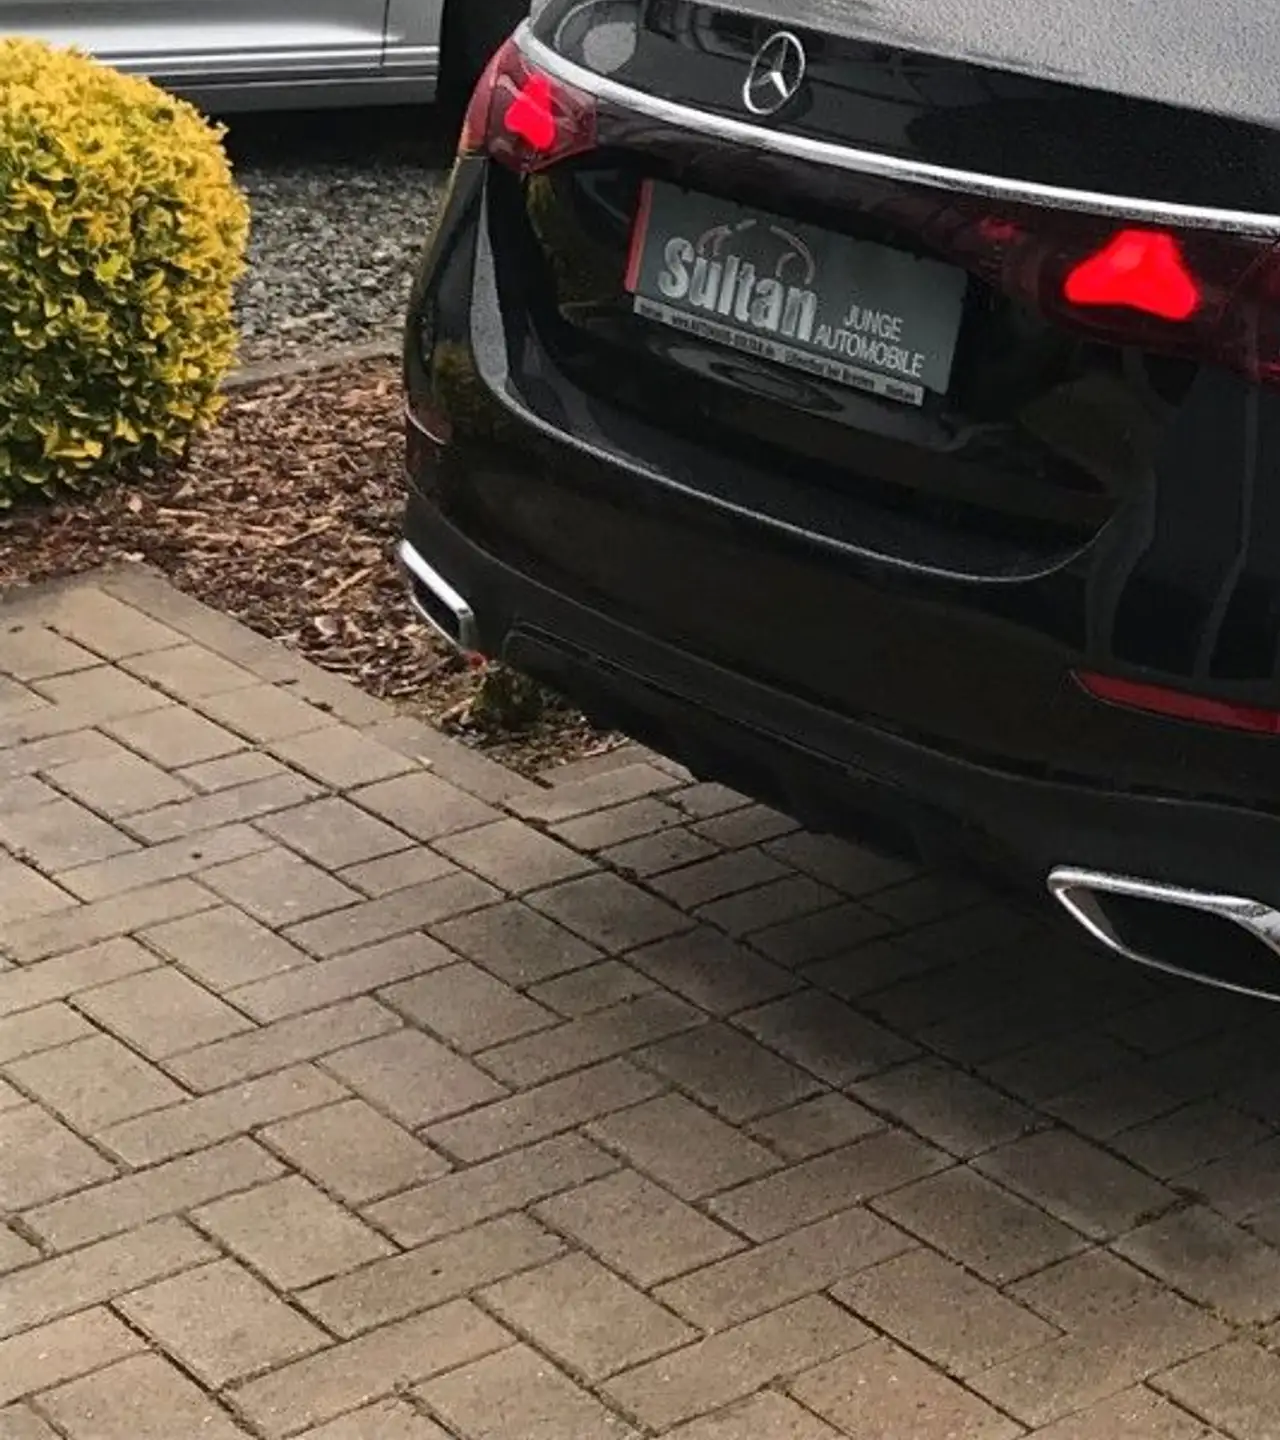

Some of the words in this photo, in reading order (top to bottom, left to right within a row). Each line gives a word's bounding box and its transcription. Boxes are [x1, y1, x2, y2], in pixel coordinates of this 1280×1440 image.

[658, 236, 818, 343] Sultan
[814, 323, 925, 379] AUTOMOBILE
[845, 305, 904, 343] JUNGE
